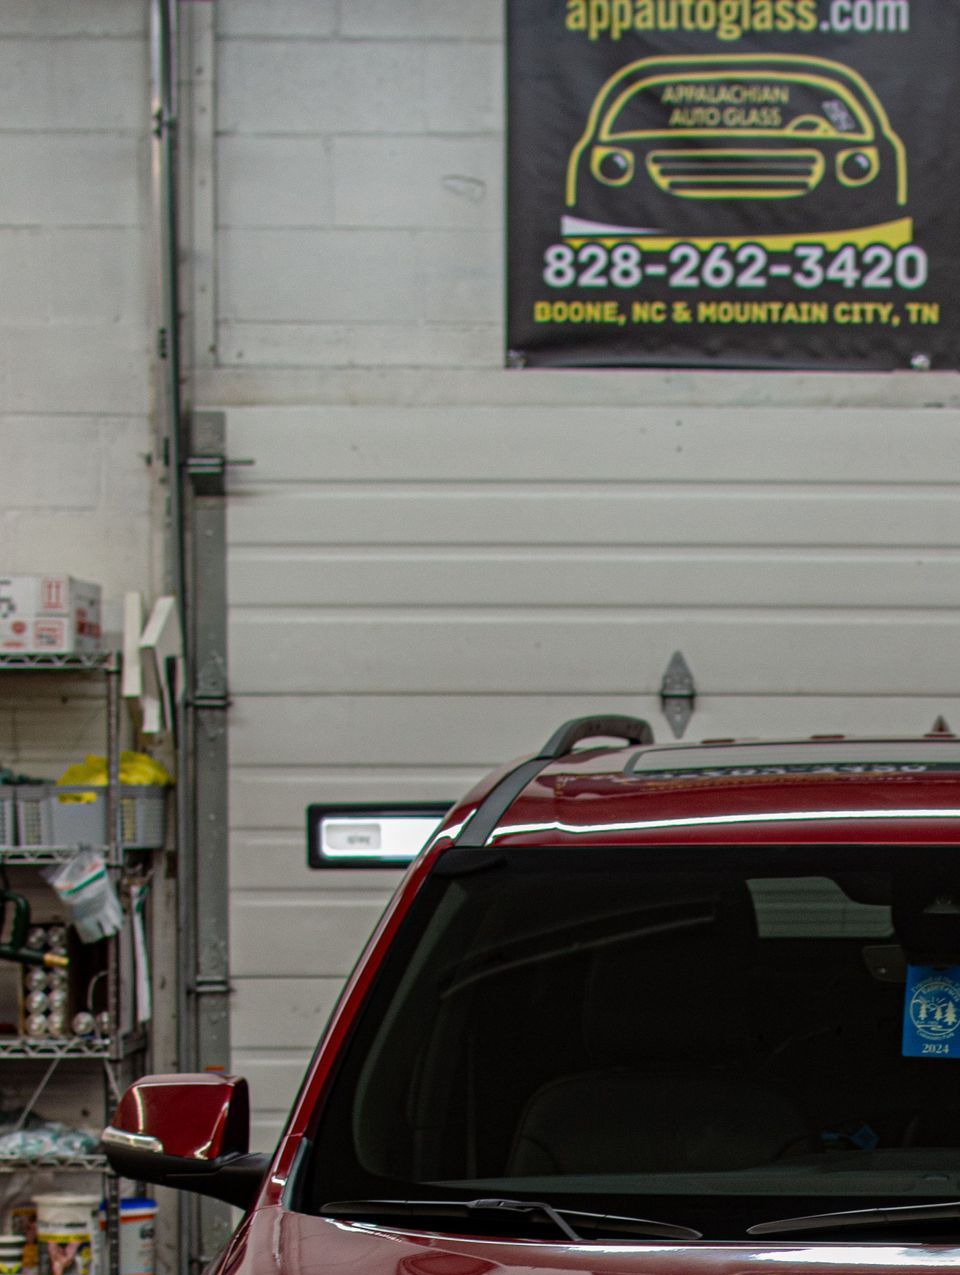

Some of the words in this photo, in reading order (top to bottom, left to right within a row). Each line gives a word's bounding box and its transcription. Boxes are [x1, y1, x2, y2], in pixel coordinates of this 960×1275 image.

[566, 0, 909, 40] appautoglass.com
[661, 85, 789, 105] APPALACHIAN
[669, 107, 720, 127] AUTO
[722, 106, 782, 127] GLASS
[543, 244, 928, 288] 828-262-3420
[534, 301, 626, 325] BOONE,
[632, 302, 667, 323] NC
[672, 302, 692, 323] &
[698, 302, 829, 323] MOUNTAIN
[834, 302, 901, 326] CITY,
[906, 302, 939, 324] TN
[922, 1043, 949, 1054] 2024
